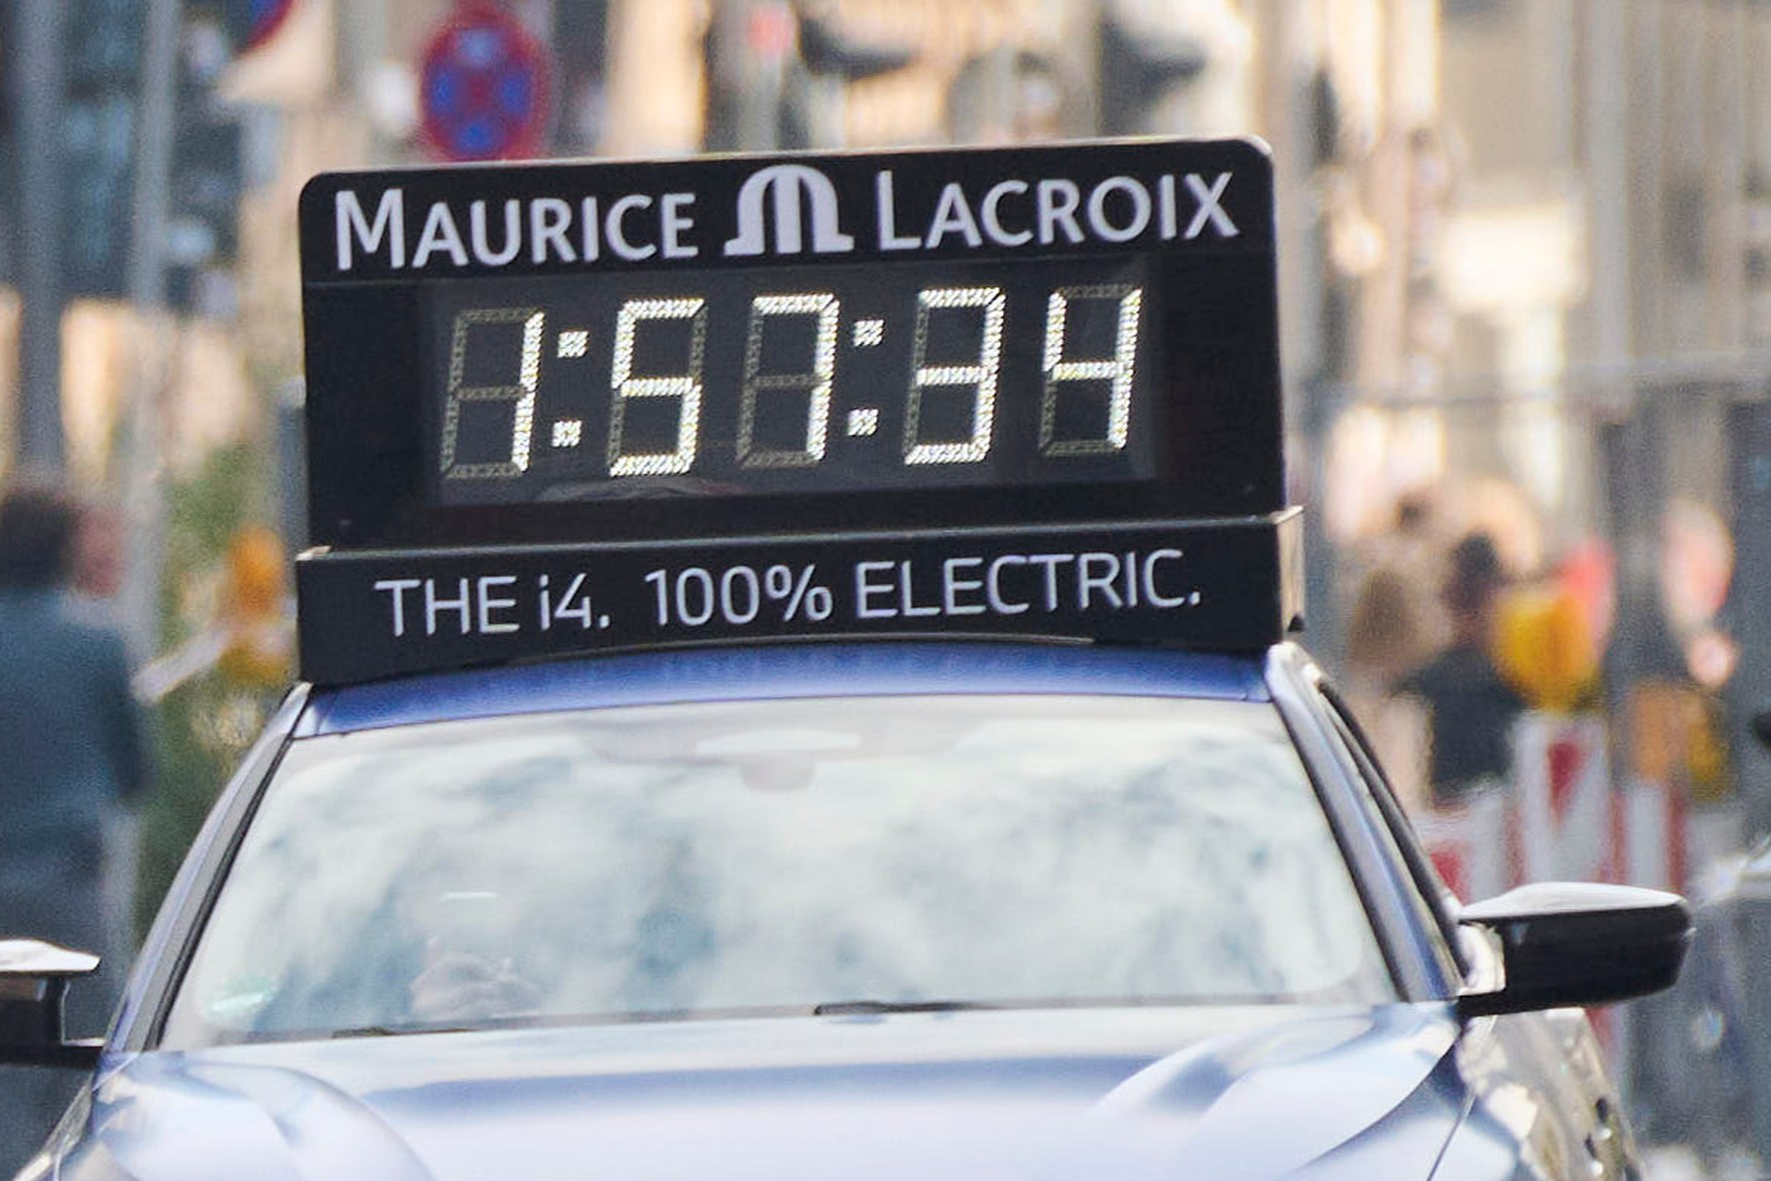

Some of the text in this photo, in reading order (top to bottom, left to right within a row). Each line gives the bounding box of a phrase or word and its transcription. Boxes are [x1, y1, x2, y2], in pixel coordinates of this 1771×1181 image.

[335, 188, 699, 271] MAURICE
[876, 170, 1240, 251] LACROIX
[510, 286, 1143, 478] 1:57:34
[374, 548, 1201, 637] THE i4. 100% ELECTRIC.
